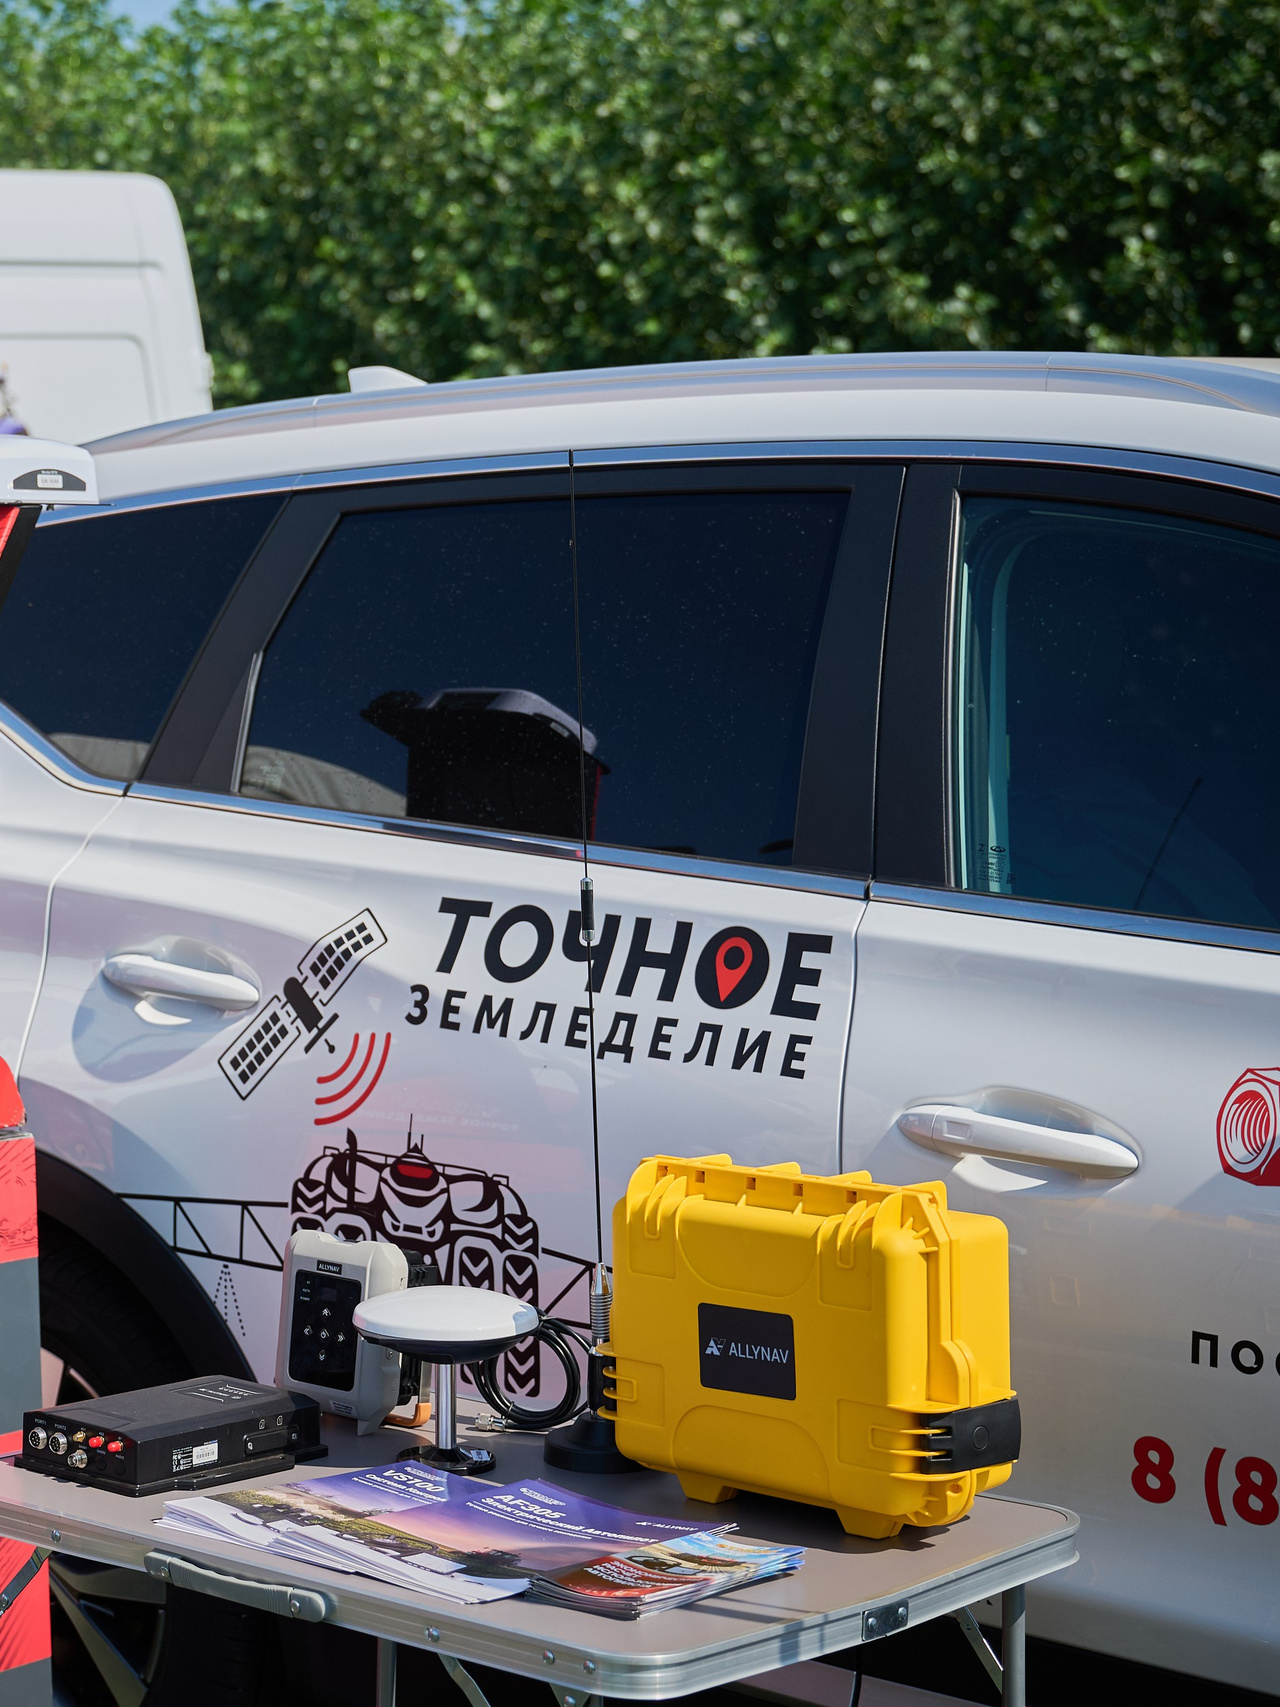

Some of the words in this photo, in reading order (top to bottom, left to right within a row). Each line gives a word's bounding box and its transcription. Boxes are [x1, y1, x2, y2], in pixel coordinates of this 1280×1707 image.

[436, 896, 834, 1021] ТОЧНОЕ
[405, 984, 814, 1080] ЗЕМЛЕДЕЛИЕ
[318, 1263, 340, 1272] ALLYNAV
[728, 1341, 789, 1364] ALLYNAV
[1191, 1330, 1280, 1377] ПО
[382, 1469, 445, 1492] VS100
[1131, 1436, 1176, 1504] 8
[1204, 1446, 1280, 1527] (8
[493, 1494, 567, 1519] AF305
